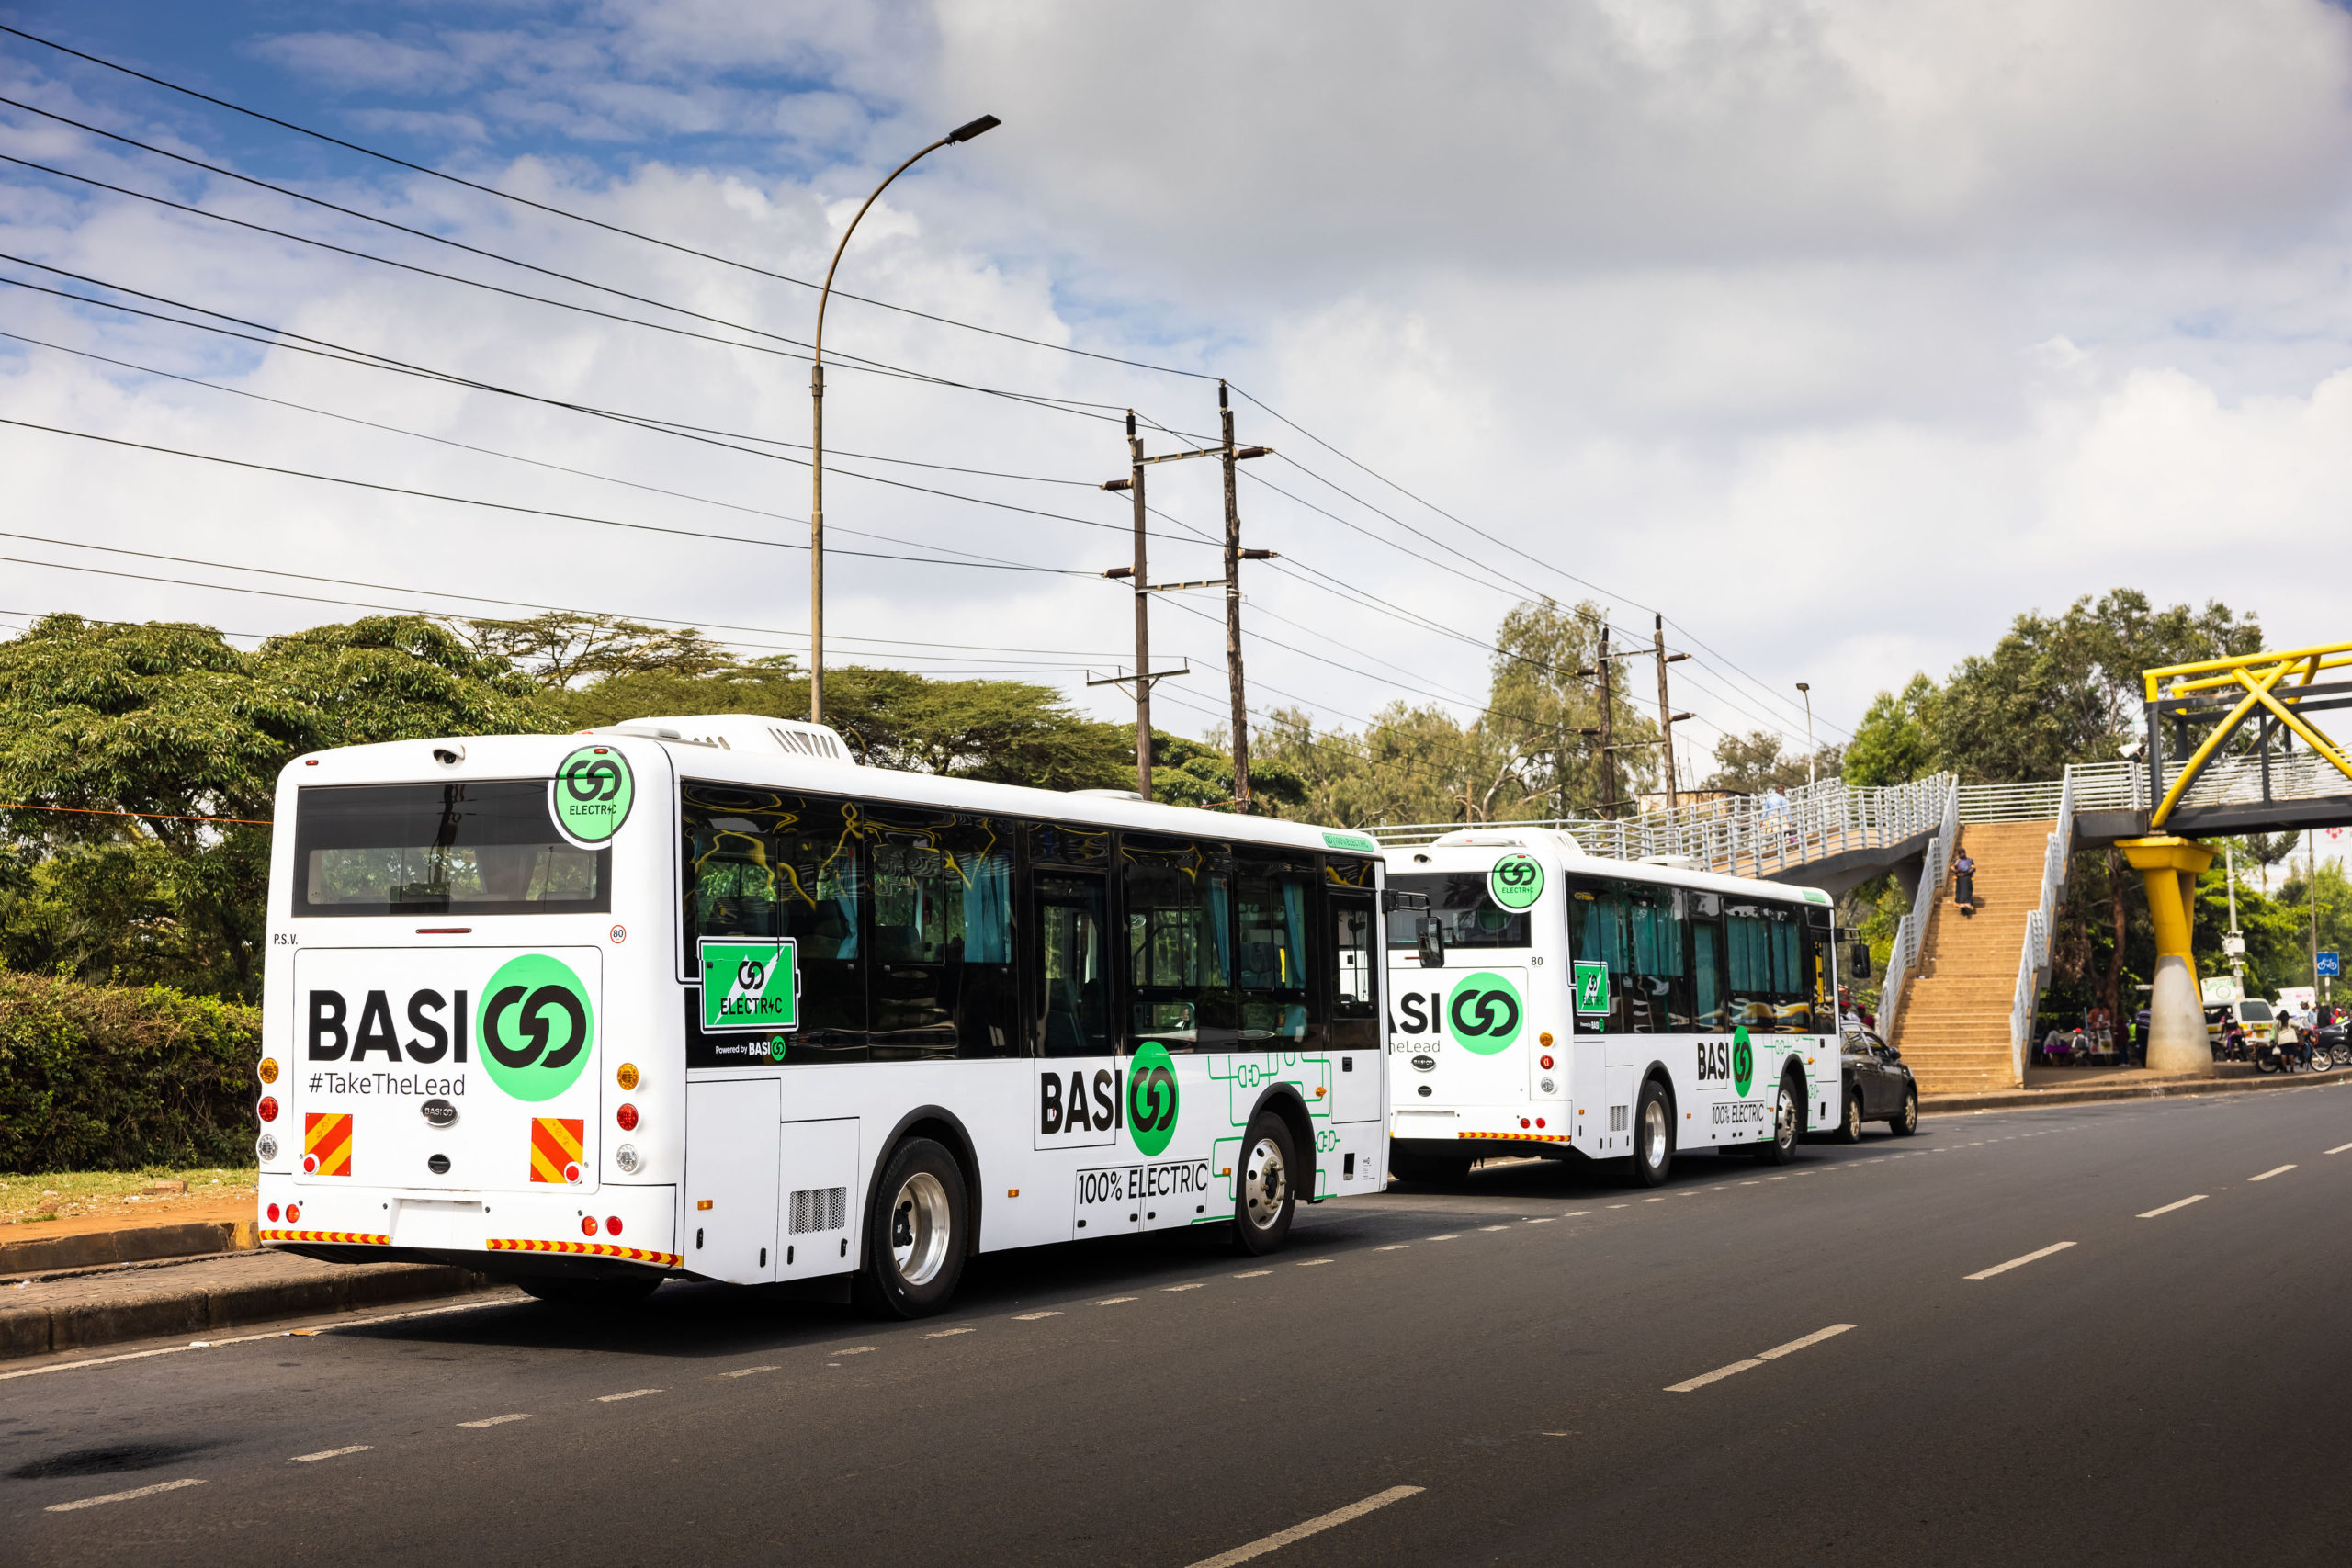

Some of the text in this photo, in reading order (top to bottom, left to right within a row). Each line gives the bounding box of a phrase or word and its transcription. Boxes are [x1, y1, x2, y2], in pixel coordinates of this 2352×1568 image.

[274, 933, 298, 945] P.S.V.
[613, 929, 624, 938] 80
[1531, 956, 1544, 965] 80
[716, 1045, 740, 1055] Powered
[740, 1043, 748, 1055] by
[309, 1072, 465, 1096] #TakeTheLead
[1713, 1103, 1764, 1125] 100% ELECTRIC
[1079, 1163, 1208, 1204] 100% ELECTRIC
